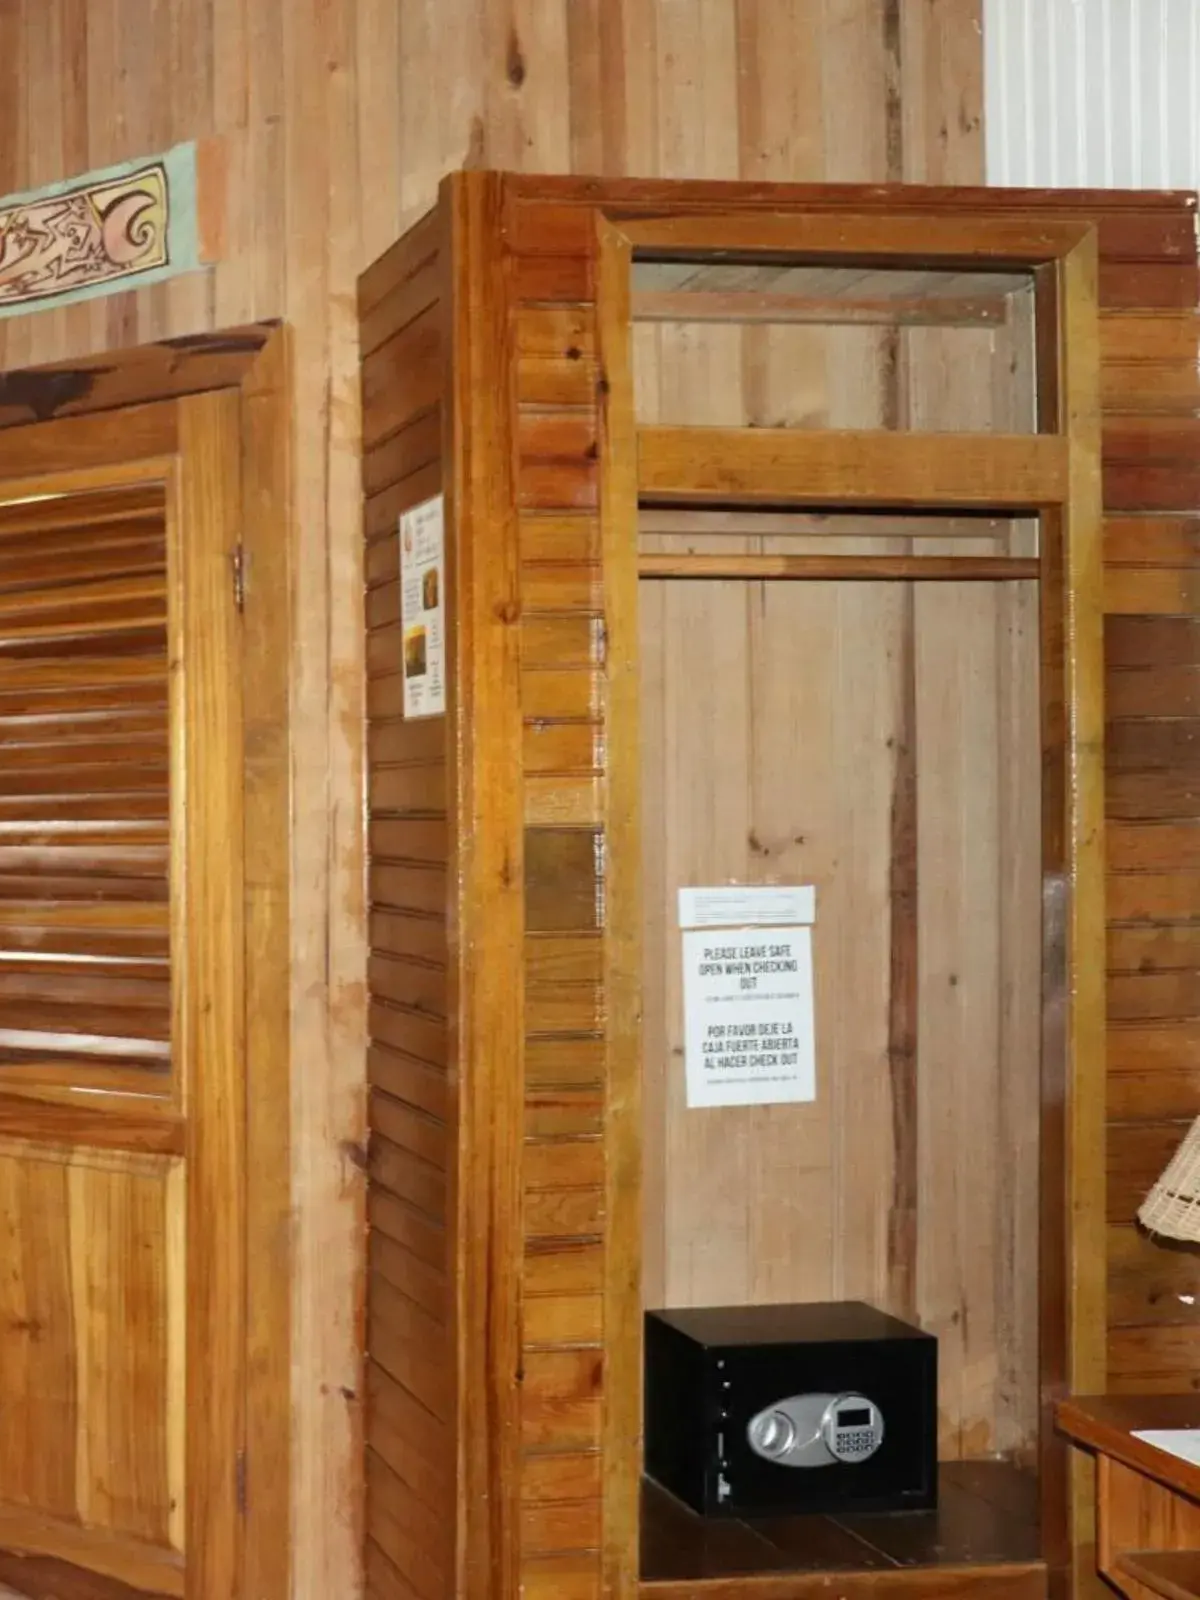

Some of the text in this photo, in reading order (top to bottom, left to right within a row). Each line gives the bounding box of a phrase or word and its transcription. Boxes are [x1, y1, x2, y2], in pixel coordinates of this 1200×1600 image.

[703, 944, 791, 960] PLEASE LEAVE SAFE
[699, 960, 798, 976] OPEN WHEN CHECKING
[740, 977, 757, 990] OUT
[708, 1022, 793, 1037] POR FAVOR DEJE LA
[702, 1038, 799, 1054] CAJA FUERTE ABIERTA
[704, 1052, 798, 1069] AL HACER CHECK OUT
